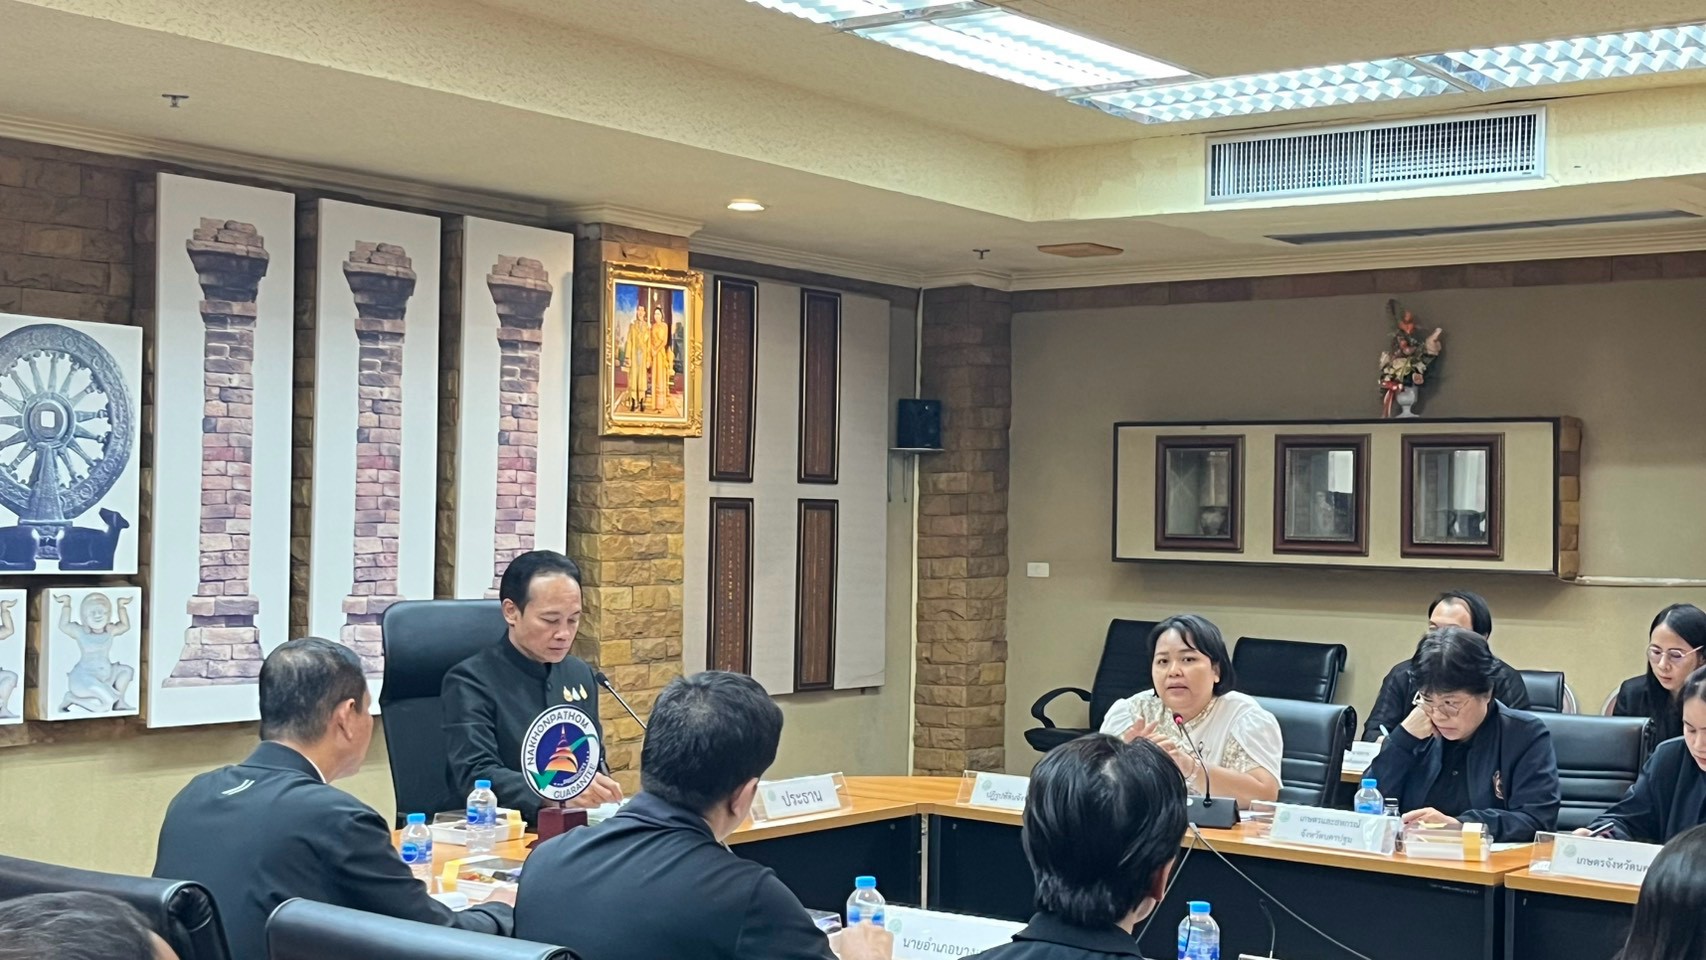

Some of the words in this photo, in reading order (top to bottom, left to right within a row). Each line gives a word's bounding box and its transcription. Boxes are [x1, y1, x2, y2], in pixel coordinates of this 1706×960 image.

[527, 711, 589, 766] NAKHONPATHOM
[553, 763, 595, 799] GUARANTEE
[781, 790, 823, 807] ประธาน
